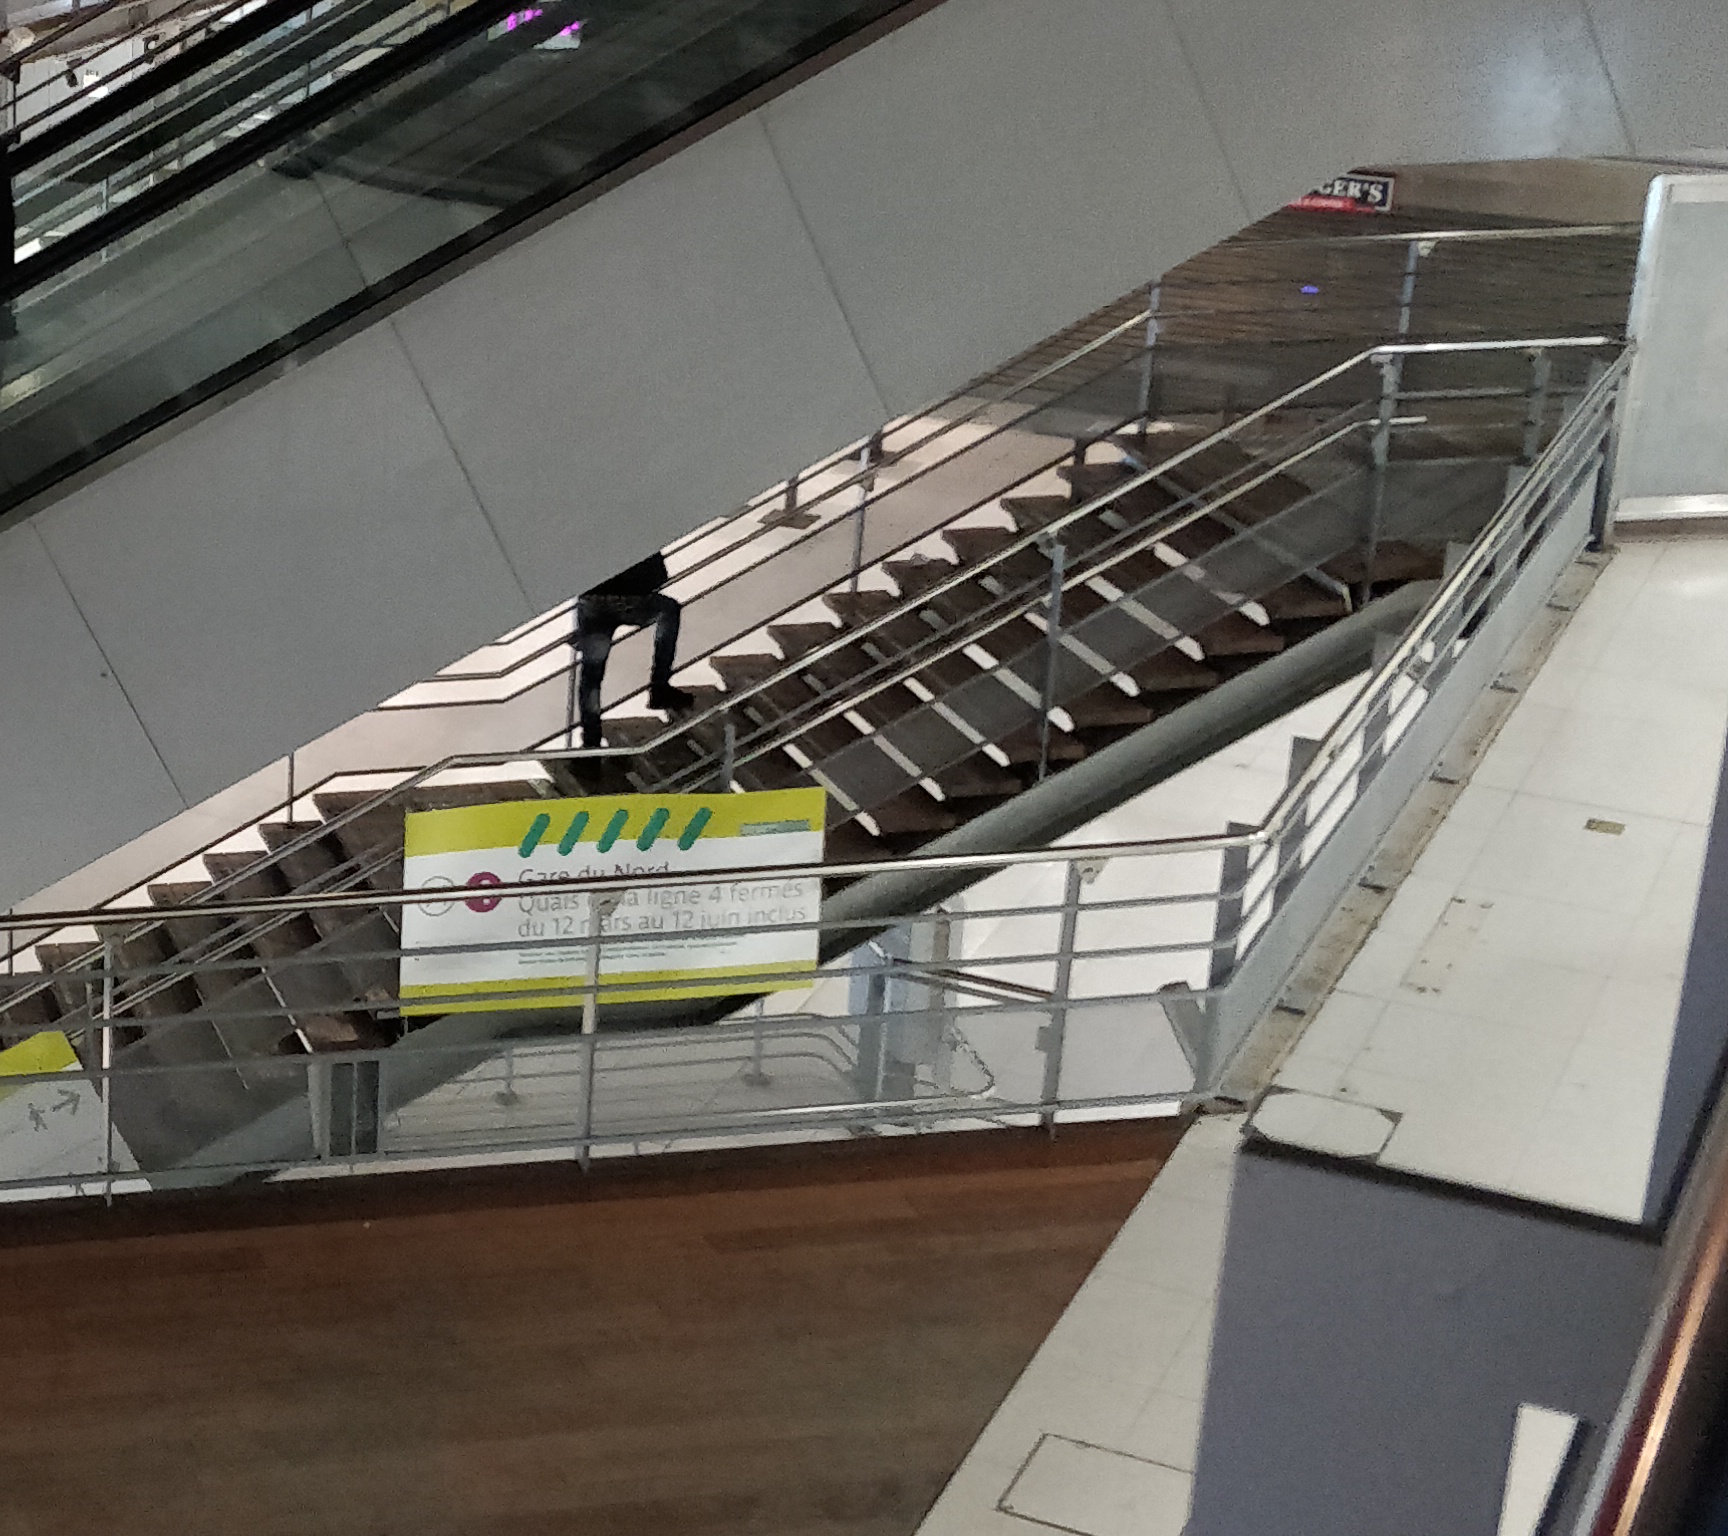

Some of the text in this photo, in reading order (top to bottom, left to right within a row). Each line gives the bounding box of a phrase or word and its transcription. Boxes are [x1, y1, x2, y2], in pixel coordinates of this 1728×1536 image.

[518, 918, 545, 937] du
[553, 916, 573, 935] 12
[638, 914, 664, 930] au
[673, 910, 693, 929] 12
